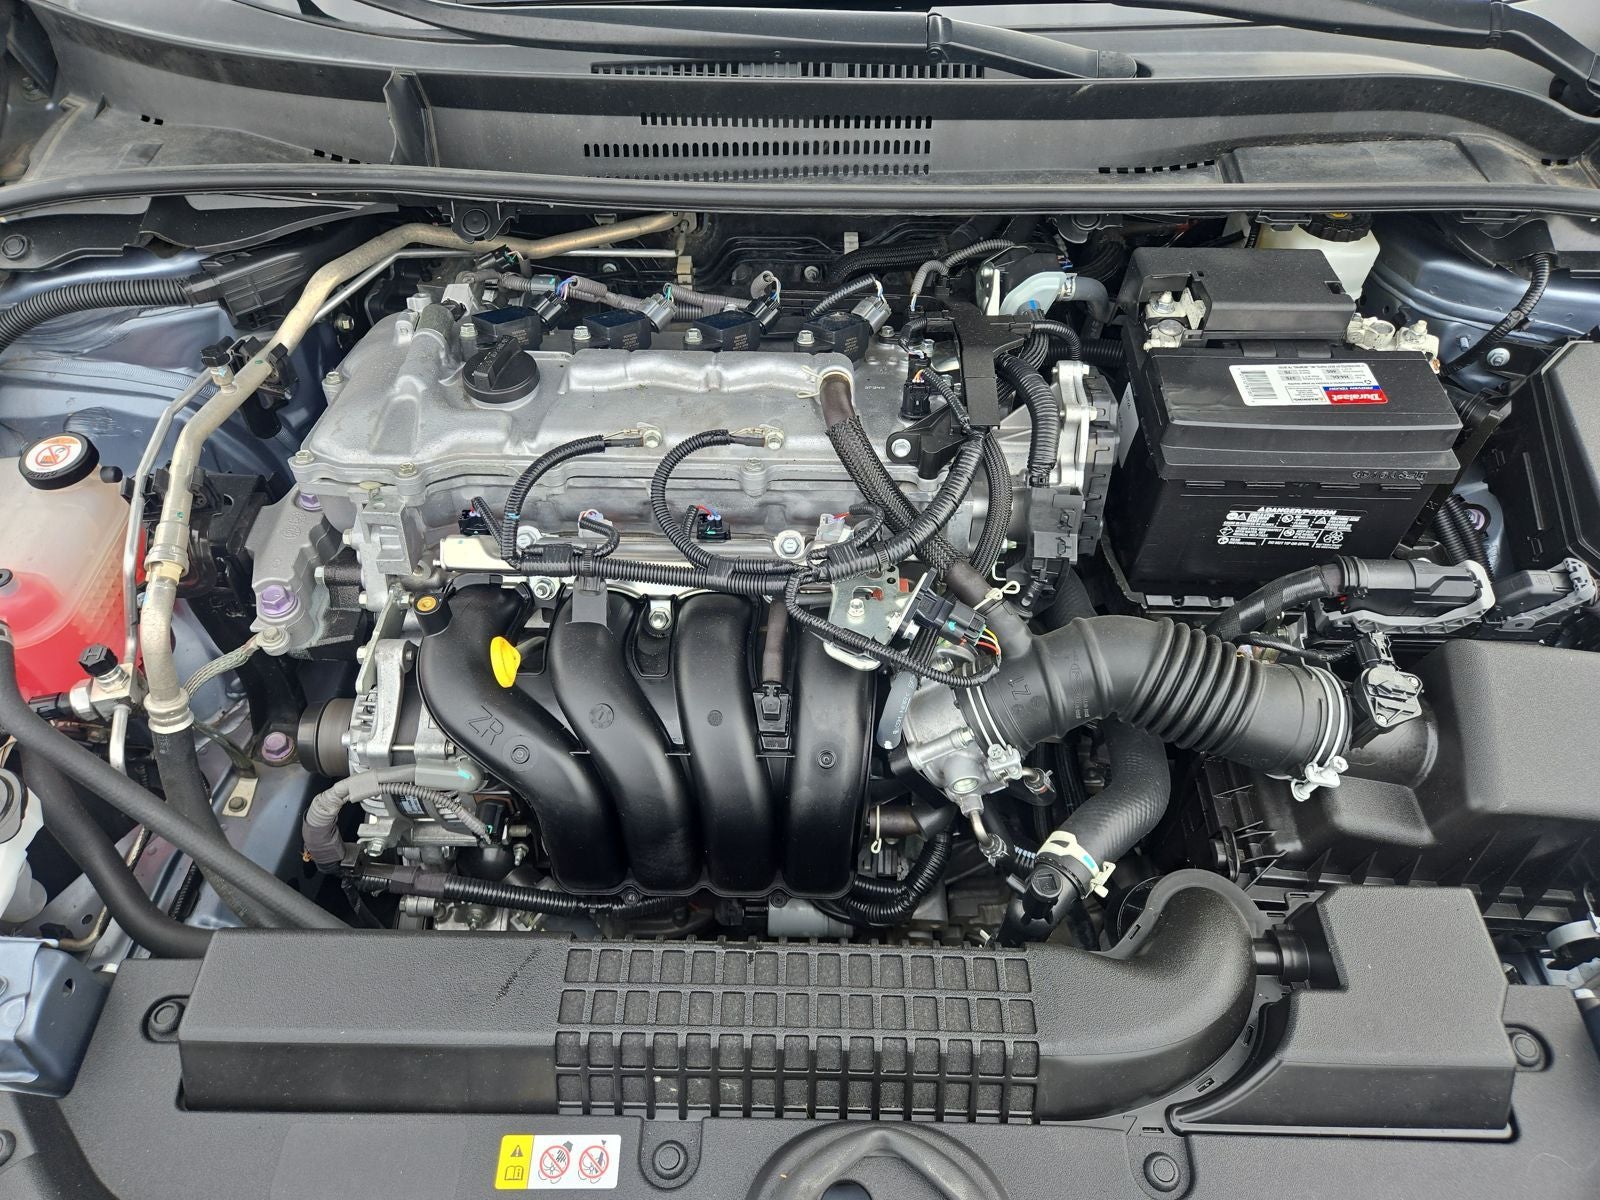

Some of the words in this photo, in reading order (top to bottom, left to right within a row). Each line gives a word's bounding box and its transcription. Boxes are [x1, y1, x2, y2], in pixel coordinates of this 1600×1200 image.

[1331, 393, 1382, 402] Duralast
[1265, 507, 1337, 515] DANGER/POISON
[466, 704, 504, 746] ZR
